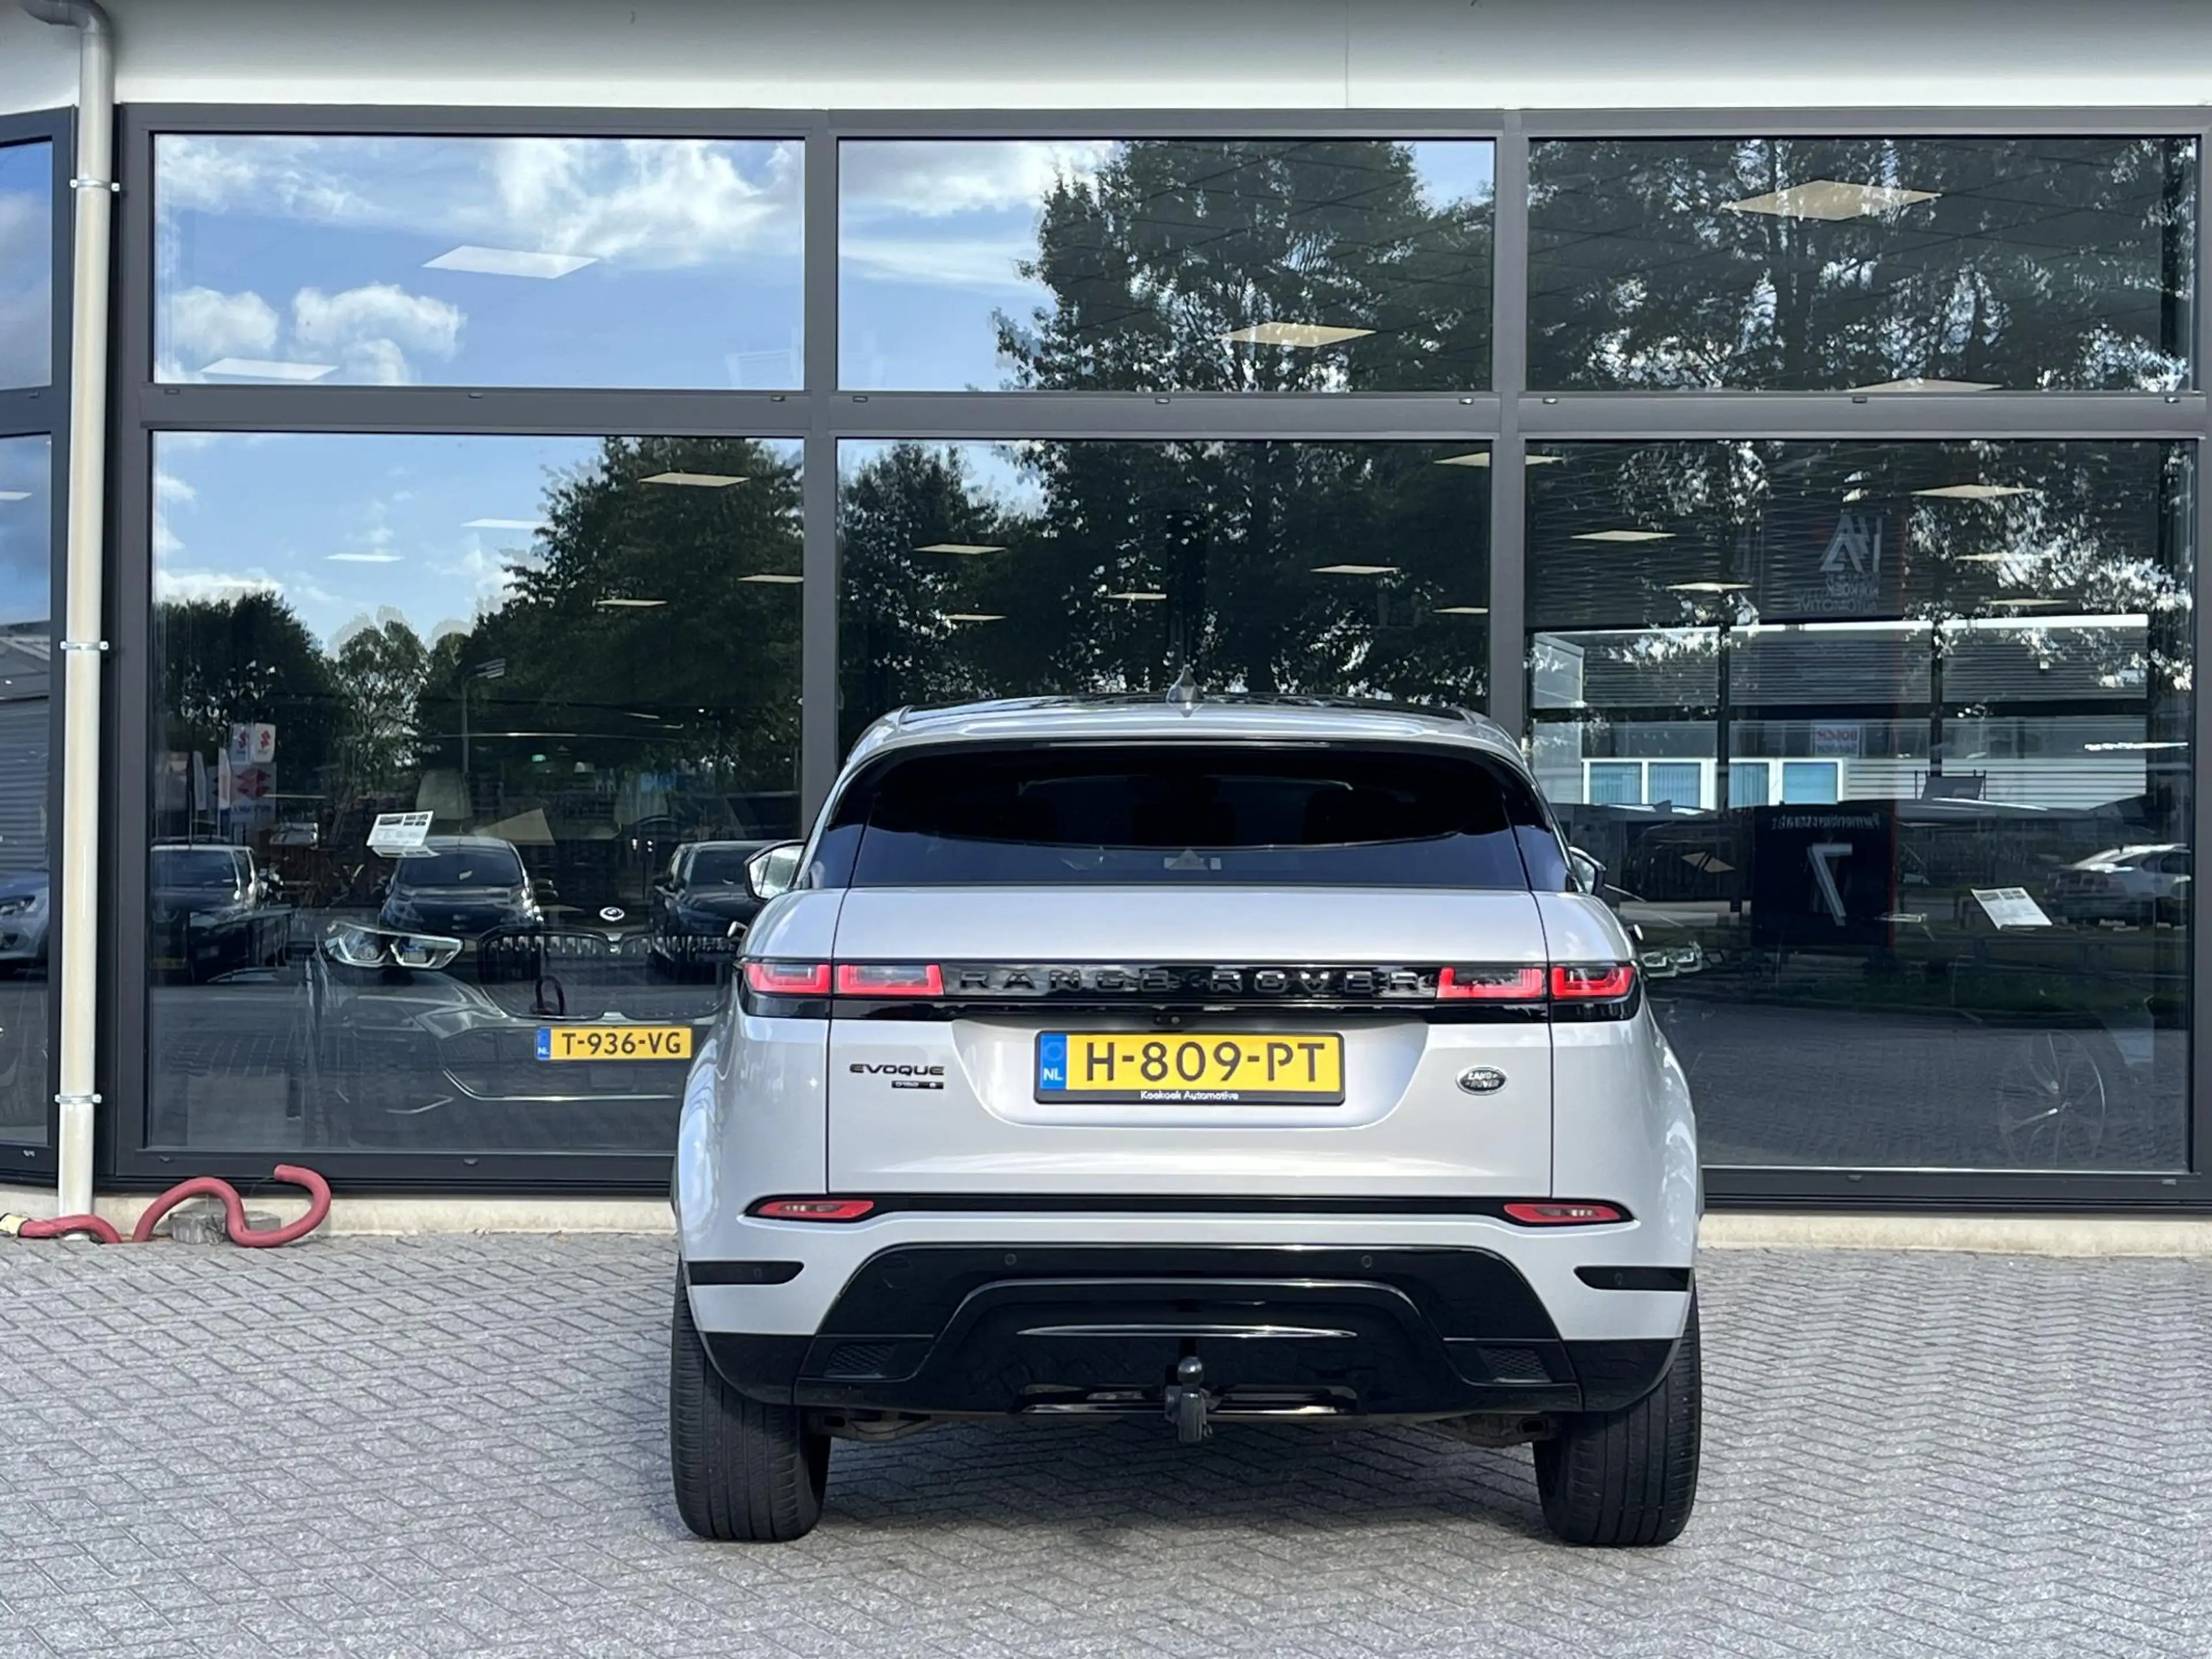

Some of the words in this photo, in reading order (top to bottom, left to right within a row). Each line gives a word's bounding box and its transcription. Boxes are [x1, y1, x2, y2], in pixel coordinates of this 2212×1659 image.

[960, 969, 1168, 991] RANGE
[1210, 970, 1421, 992] ROVER
[562, 1032, 680, 1055] T-936-VG
[1086, 1041, 1325, 1082] H-809-PT
[849, 1063, 944, 1077] EVOQUE
[1043, 1068, 1063, 1081] NL
[1467, 1070, 1492, 1080] LAND
[1184, 1090, 1238, 1100] Automotive
